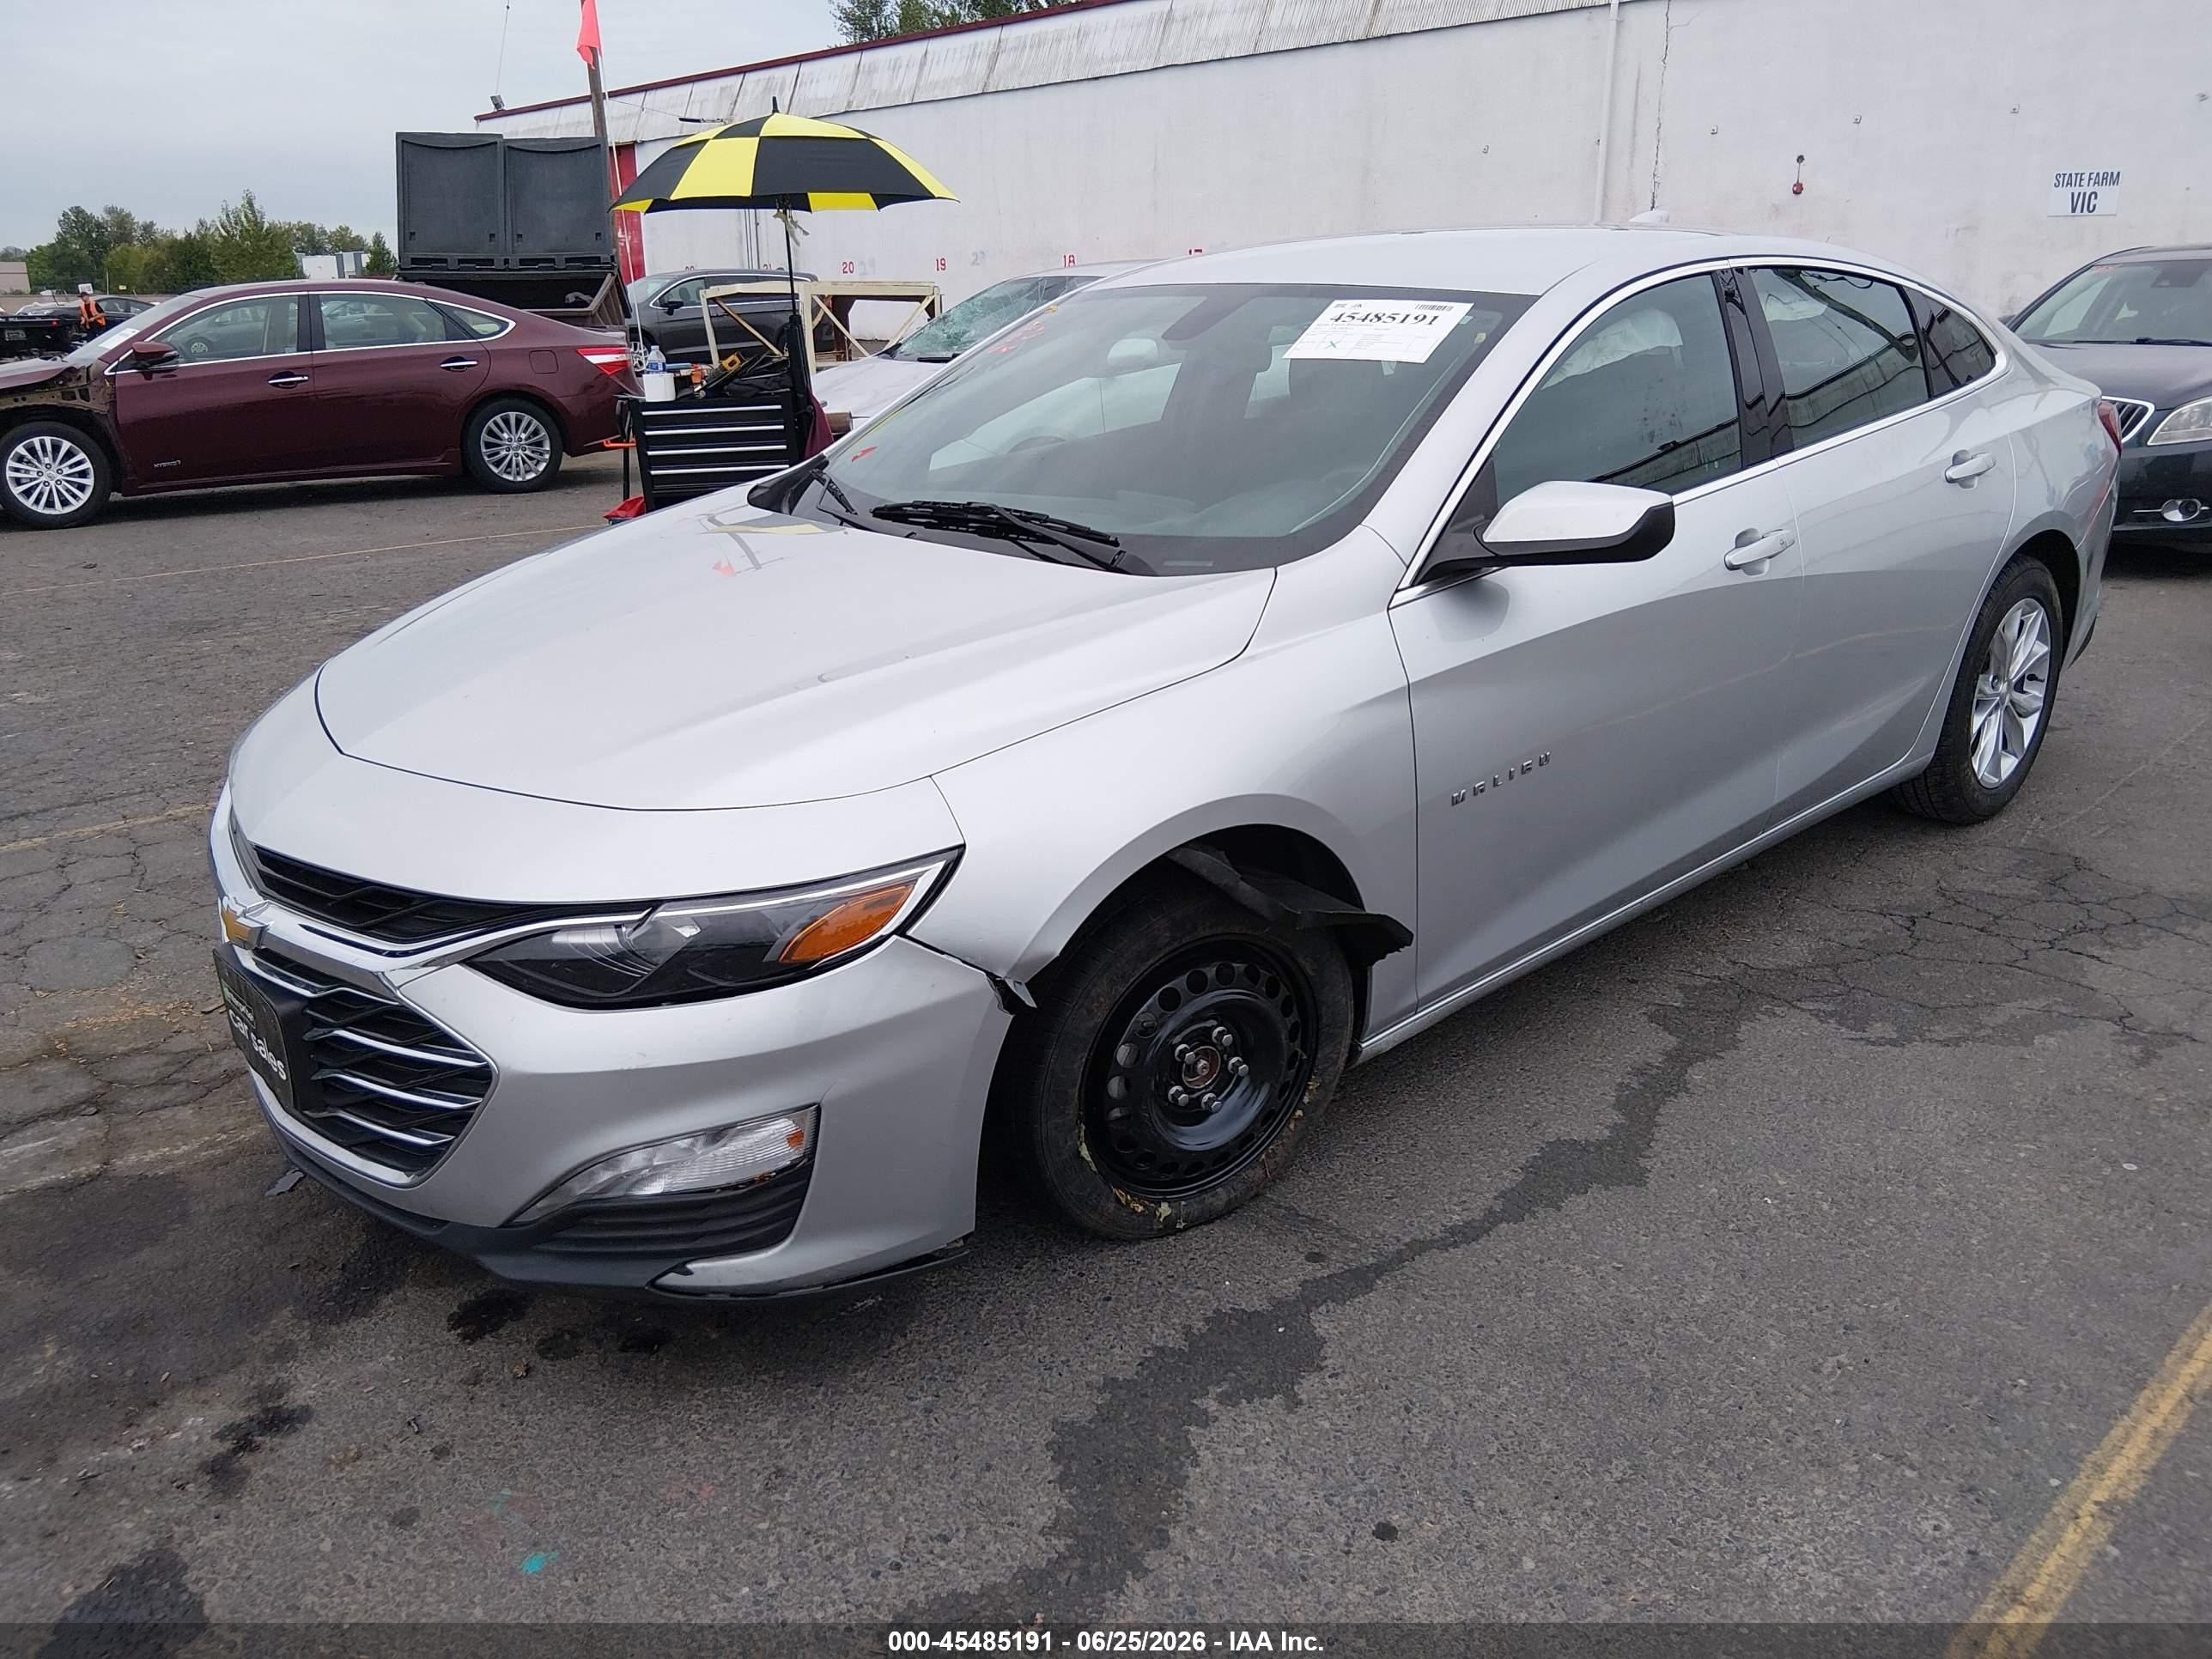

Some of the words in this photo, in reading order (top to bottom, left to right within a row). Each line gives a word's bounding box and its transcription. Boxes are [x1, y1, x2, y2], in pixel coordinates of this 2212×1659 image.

[2054, 173, 2085, 187] STATE
[2087, 171, 2120, 186] FARM
[2070, 191, 2098, 213] VIC
[842, 261, 854, 274] 20
[936, 258, 946, 271] 19
[1329, 312, 1439, 325] 45485191
[1451, 750, 1550, 805] MALIBU
